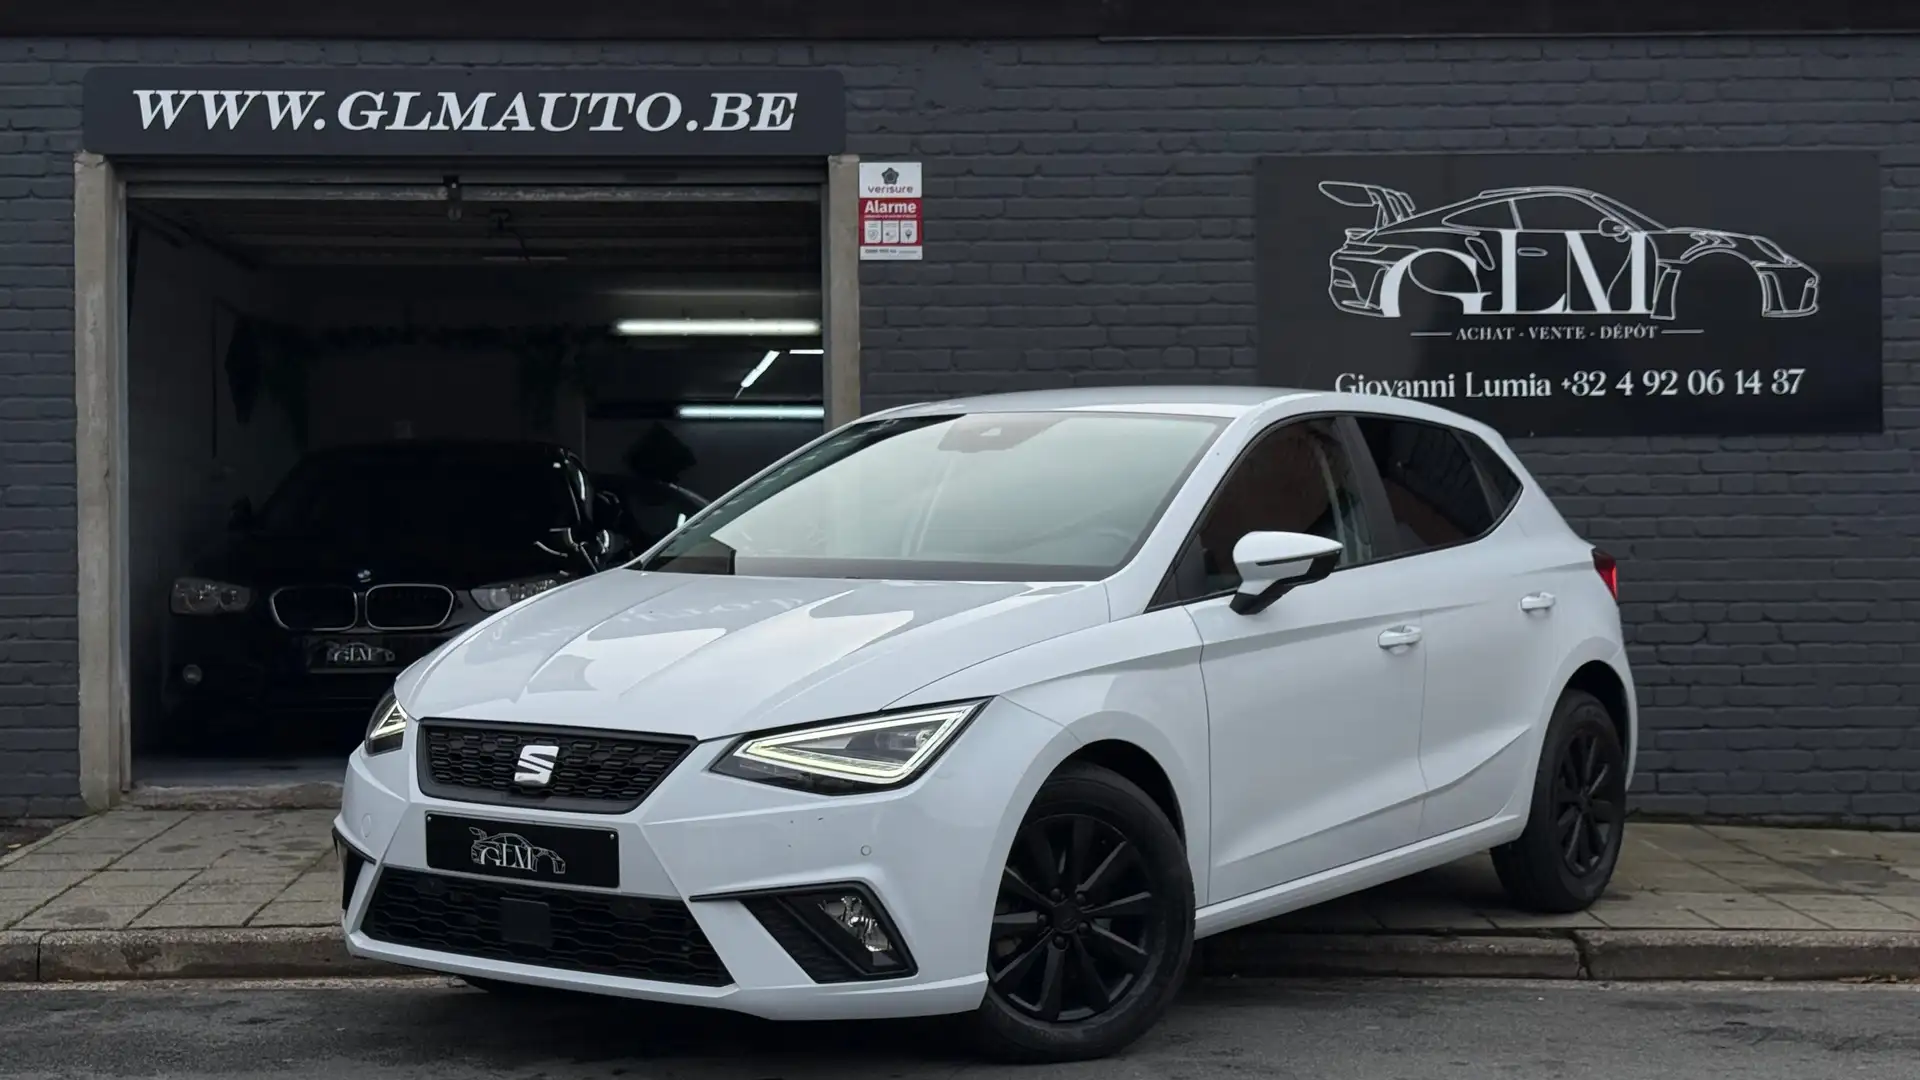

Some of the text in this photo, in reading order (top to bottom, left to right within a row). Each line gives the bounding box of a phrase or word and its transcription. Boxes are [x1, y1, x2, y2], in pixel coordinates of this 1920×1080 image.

[132, 89, 798, 133] WWW.GLMAUTO.BE
[868, 185, 914, 194] verisure
[864, 200, 916, 213] Alarme
[1380, 229, 1655, 318] GLM
[1456, 327, 1515, 341] ACHAT
[1528, 326, 1586, 340] VENTE
[1335, 369, 1806, 398] Giovanni Lumia +32 4 92 06 14 37
